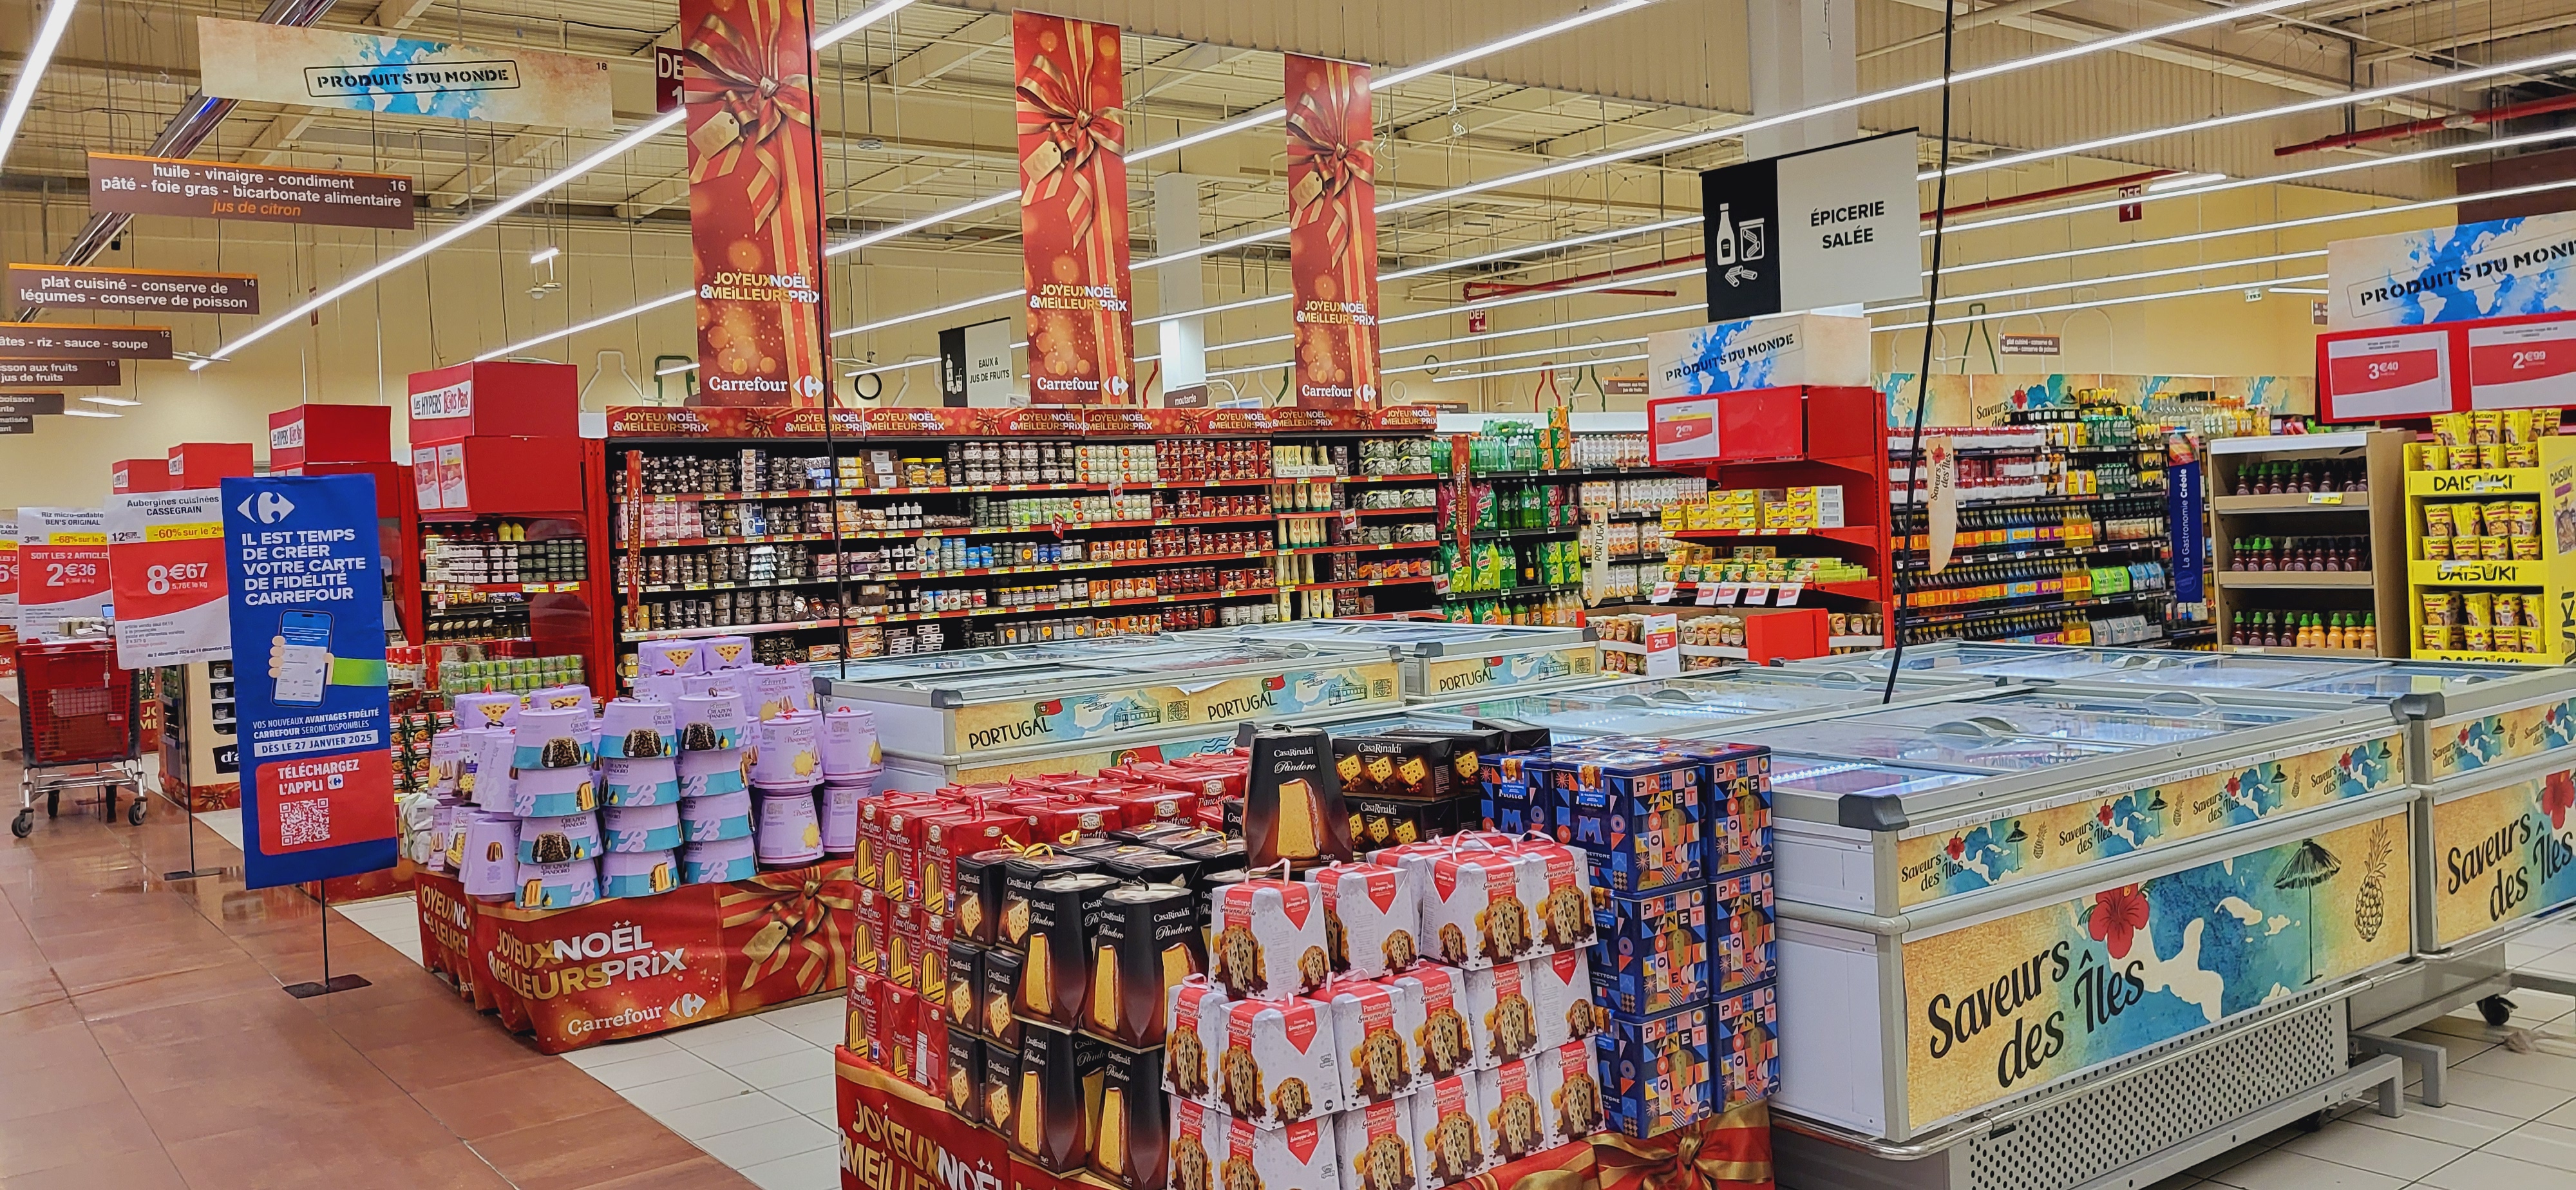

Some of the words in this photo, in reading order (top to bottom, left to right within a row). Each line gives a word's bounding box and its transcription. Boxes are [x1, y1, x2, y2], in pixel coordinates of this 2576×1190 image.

[596, 62, 607, 71] 18
[658, 52, 683, 81] DE
[317, 73, 413, 89] PRODUITS
[415, 71, 440, 85] DU
[444, 69, 509, 83] MONDE
[672, 85, 683, 106] 1
[153, 164, 190, 179] huile
[205, 167, 264, 185] vinaigre
[278, 175, 354, 189] condiment
[101, 176, 136, 193] pâté
[151, 179, 181, 194] foie
[185, 185, 218, 198] gras
[232, 184, 321, 203] bicarbonate
[324, 192, 402, 207] alimentaire
[390, 180, 406, 193] 16
[211, 198, 234, 214] jus
[238, 200, 256, 214] de
[261, 202, 301, 216] citron
[1810, 200, 1884, 227] ÉPICERIE
[1822, 227, 1873, 249] SALÉE
[243, 279, 254, 287] 14
[2360, 267, 2471, 307] PRODUITS
[2476, 258, 2508, 278] DU
[2513, 240, 2576, 269] MON
[41, 275, 70, 290] plat
[75, 277, 127, 290] cuisiné
[141, 281, 207, 293] conserve
[211, 282, 228, 294] de
[21, 288, 86, 304] légumes
[100, 294, 167, 306] conserve
[171, 294, 189, 306] de
[193, 297, 247, 309] poisson
[1470, 309, 1484, 320] DEF
[0, 337, 25, 346] âtes
[37, 337, 53, 347] riz
[64, 339, 100, 348] sauce
[112, 340, 148, 351] soupe
[978, 358, 992, 368] EAUX
[994, 357, 999, 366] &
[1666, 355, 1727, 381] PRODUITS
[1728, 348, 1745, 363] DU
[1747, 334, 1794, 357] MONDE
[51, 363, 78, 372] fruits
[970, 374, 980, 384] JUS
[981, 373, 989, 381] DE
[990, 370, 1010, 381] FRUITS
[1, 373, 17, 382] jus
[20, 373, 33, 382] de
[36, 373, 63, 382] fruits
[709, 375, 788, 392] Carrefour
[1037, 376, 1099, 392] Carrefour
[1175, 393, 1197, 406] moutarde
[1302, 384, 1352, 397] Carrefour
[421, 393, 441, 415] HYPERS
[1976, 400, 2008, 420] Saveurs
[1931, 467, 1942, 500] Saveurs
[2179, 468, 2188, 498] Créole
[127, 497, 176, 508] Aubergines
[179, 495, 220, 505] cuisinées
[146, 506, 202, 516] CASSEGRAIN
[55, 535, 77, 543] -68%
[153, 528, 182, 539] -60%
[242, 533, 257, 546] IL
[261, 531, 293, 545] EST
[297, 529, 355, 543] TEMPS
[1594, 518, 1605, 562] PORTUGAL
[243, 547, 267, 561] DE
[272, 543, 330, 559] CRÉER
[243, 560, 305, 576] VOTRE
[308, 557, 366, 572] CARTE
[2182, 557, 2190, 568] La
[46, 563, 96, 587] 2€36
[147, 563, 208, 595] 8€67
[245, 578, 269, 591] DE
[273, 569, 347, 589] FIDÉLITÉ
[199, 581, 208, 590] kg
[245, 587, 354, 606] CARREFOUR
[1439, 668, 1497, 692] PORTUGAL
[1208, 692, 1278, 721] PORTUGAL
[252, 721, 266, 729] VOS
[268, 717, 303, 728] NOUVEAUX
[305, 712, 347, 724] AVANTAGES
[348, 707, 379, 720] FIDÉLITÉ
[254, 727, 300, 739] CARREFOUR
[301, 724, 327, 734] SERONT
[328, 720, 370, 732] DISPONIBLES
[969, 716, 1054, 750] PORTUGAL
[262, 743, 279, 753] DÈS
[282, 742, 292, 751] LE
[294, 742, 306, 750] 27
[309, 736, 346, 748] JANVIER
[348, 733, 372, 744] 2025
[1274, 746, 1314, 758] CasaRinaldi
[1358, 742, 1402, 754] CasaRinaldi
[278, 759, 360, 780] TÉLÉCHARGEZ
[1274, 760, 1317, 774] Pandoro
[279, 780, 323, 796] L'APPLI
[1360, 802, 1397, 815] CasaRinaldi
[2193, 791, 2223, 815] Saveurs
[2208, 807, 2222, 823] des
[1577, 816, 1604, 845] M
[2060, 820, 2094, 846] Saveurs
[2077, 838, 2093, 855] des
[2094, 824, 2113, 844] Îles
[2447, 813, 2531, 895] Saveurs
[1901, 853, 1942, 882] Saveurs
[1920, 873, 1940, 891] des
[1942, 857, 1964, 880] Îles
[2490, 866, 2528, 921] des
[2533, 821, 2574, 885] Îles
[1030, 912, 1055, 927] Pandoro
[1154, 907, 1189, 923] CasaRinaldi
[1155, 923, 1193, 940] Pandoro
[1927, 940, 2070, 1060] Saveurs
[567, 1005, 662, 1035] Carrefour
[1998, 1010, 2065, 1088] des
[2074, 950, 2145, 1034] Îles
